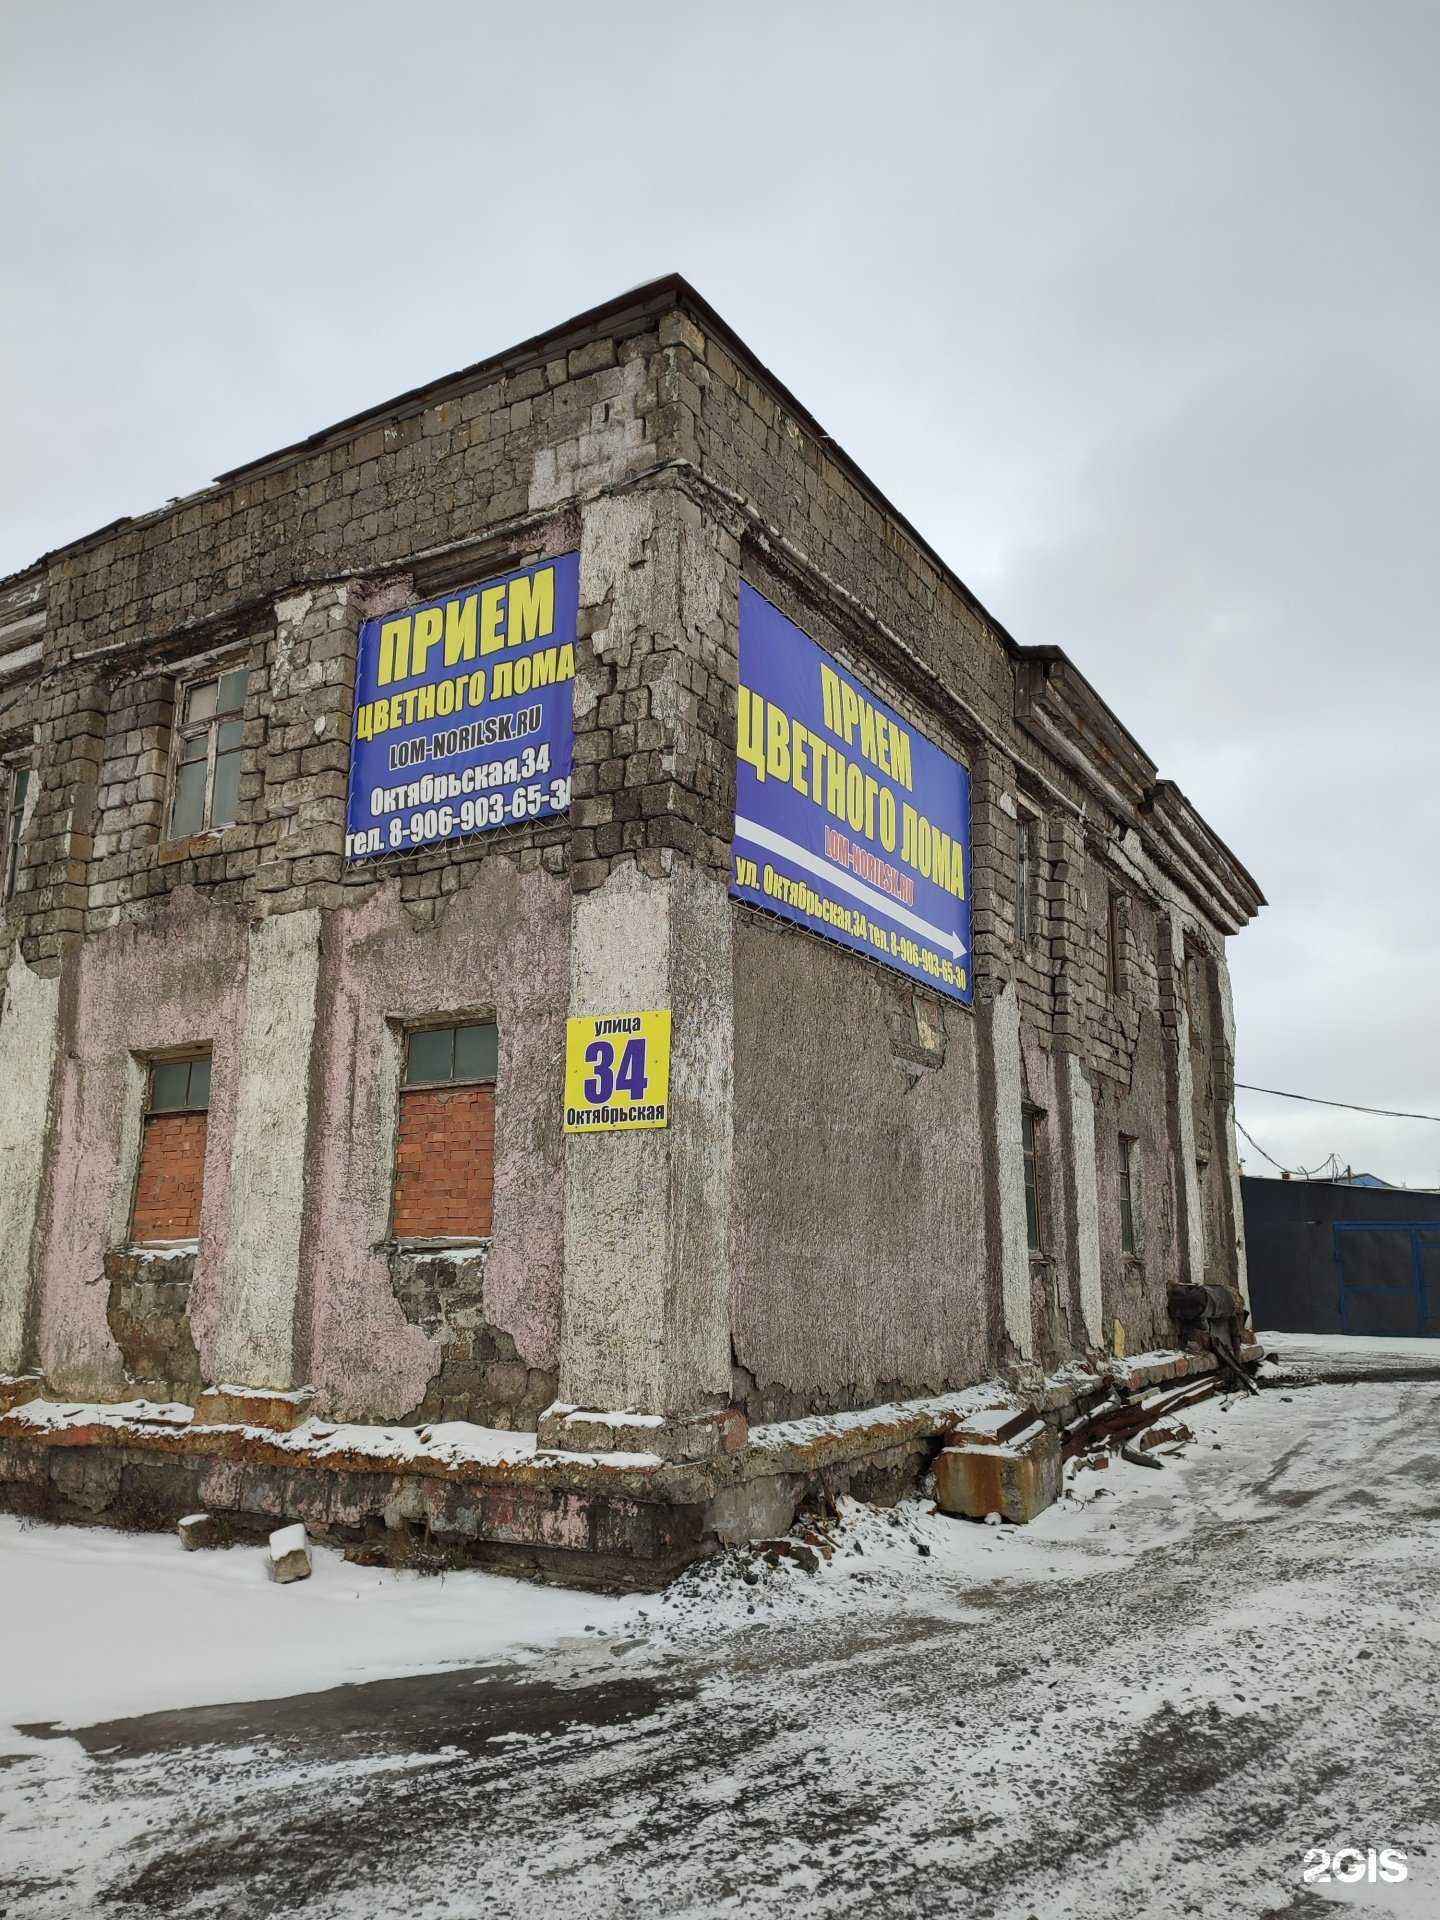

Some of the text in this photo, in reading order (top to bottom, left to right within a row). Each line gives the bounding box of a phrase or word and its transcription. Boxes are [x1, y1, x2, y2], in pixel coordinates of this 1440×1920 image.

[377, 566, 554, 687] ПРИЕМ
[357, 643, 576, 742] ЦВЕТНОГО ЛОМА
[820, 662, 913, 792] ПРИЕМ
[370, 743, 551, 816] Октябрьская,34
[389, 704, 543, 771] LOM-NORILSK.RU
[737, 684, 965, 901] ЦВЕТНОГО ЛОМА
[735, 856, 760, 890] ул.
[867, 923, 890, 954] тел.
[890, 931, 967, 992] 8-906-903-65-30
[594, 1017, 641, 1036] улица
[584, 1038, 648, 1104] 34
[567, 1104, 665, 1126] Октябрьская
